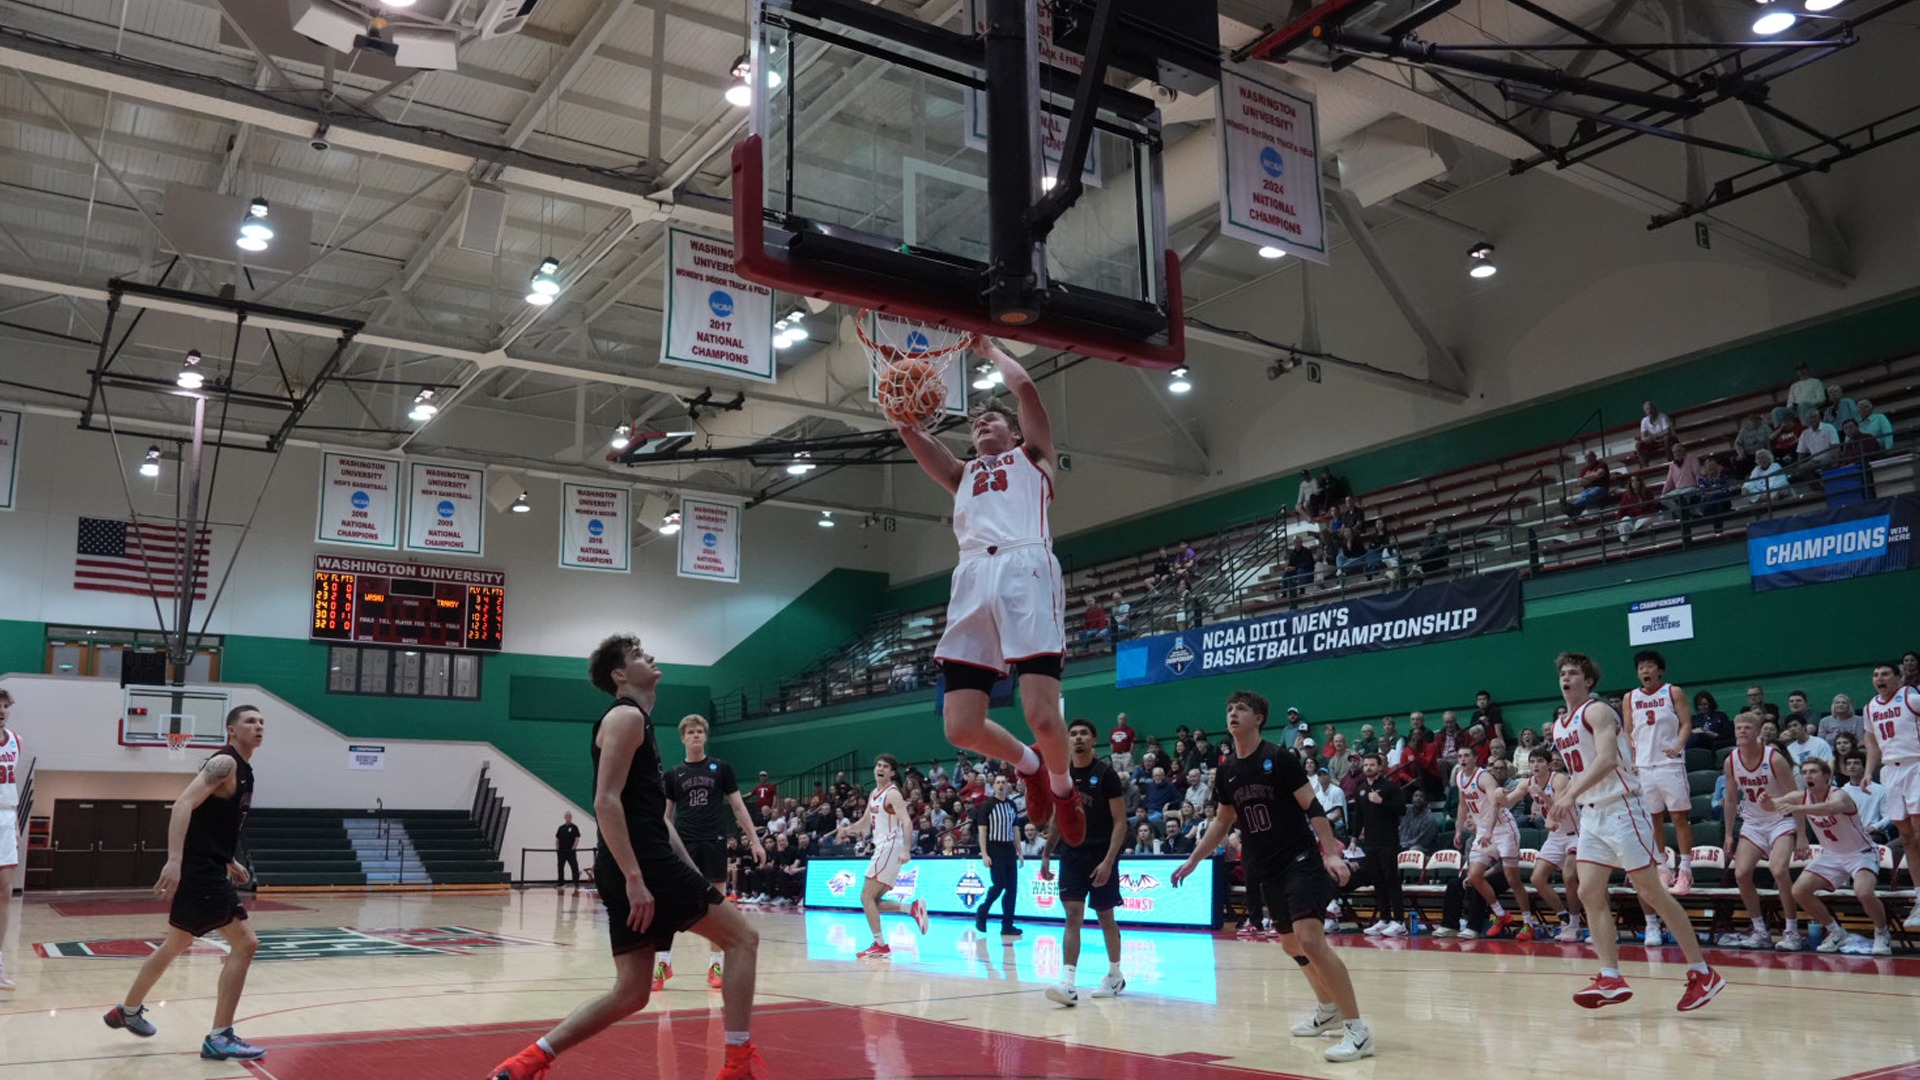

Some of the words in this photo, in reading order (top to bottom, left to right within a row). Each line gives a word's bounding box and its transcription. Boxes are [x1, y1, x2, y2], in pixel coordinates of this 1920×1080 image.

[1239, 86, 1296, 118] WASHINGTON
[1242, 104, 1294, 131] UNIVERSITY
[1262, 179, 1285, 195] 2024
[1252, 192, 1297, 216] NATIONAL
[1249, 208, 1302, 235] CHAMPIONS
[690, 240, 734, 259] WASHING
[693, 256, 735, 273] UNIVERS
[710, 319, 732, 332] 2017
[696, 331, 745, 349] NATIONAL
[691, 345, 749, 365] CHAMPIONS
[339, 459, 385, 471] WASHINGTON
[341, 469, 383, 480] UNIVERSITY
[426, 469, 470, 480] WASHINGTON
[427, 479, 467, 490] UNIVERSITY
[972, 469, 1009, 497] 23
[577, 489, 617, 499] WASHINGTON
[579, 499, 615, 508] UNIVERSITY
[341, 520, 376, 531] NATIONAL
[337, 529, 379, 540] CHAMPIONS
[428, 529, 461, 539] NATIONAL
[1890, 526, 1909, 537] WIN
[1888, 533, 1911, 543] HERE
[424, 539, 464, 549] CHAMPIONS
[1766, 527, 1886, 566] CHAMPIONS
[580, 547, 610, 556] NATIONAL
[577, 555, 613, 565] CHAMPIONS
[696, 555, 723, 565] NATIONAL
[318, 557, 416, 577] WASHINGTON
[421, 567, 503, 584] UNIVERSITY
[693, 563, 725, 573] CHAMPIONS
[316, 572, 329, 581] PLY
[331, 573, 340, 582] FL
[341, 575, 354, 583] PTS
[323, 582, 329, 591] 5
[331, 582, 338, 591] 0
[346, 584, 352, 592] 0
[469, 586, 481, 594] PLY
[482, 587, 490, 595] FL
[491, 588, 503, 596] PTS
[316, 591, 329, 600] 23
[331, 592, 338, 600] 2
[315, 600, 328, 609] 24
[330, 601, 337, 610] 0
[345, 602, 351, 611] 0
[316, 609, 327, 618] 30
[330, 610, 336, 619] 0
[472, 613, 480, 621] 10
[315, 619, 327, 628] 32
[329, 620, 336, 629] 0
[344, 621, 351, 630] 0
[471, 622, 480, 630] 12
[1203, 629, 1246, 651] NCAA
[1250, 619, 1287, 643] DIII
[1292, 608, 1349, 635] MEN'S
[1642, 620, 1681, 633] SPECTATORS
[468, 630, 480, 639] 23
[1203, 636, 1308, 670] BASKETBALL
[1313, 608, 1477, 652] CHAMPIONSHIP
[1635, 698, 1665, 710] WashU
[1645, 710, 1656, 726] 3
[1873, 707, 1902, 722] WashU
[1879, 721, 1895, 740] 10
[1739, 776, 1769, 787] WashU
[688, 787, 710, 807] 12
[758, 787, 768, 798] T
[1244, 803, 1272, 834] 10
